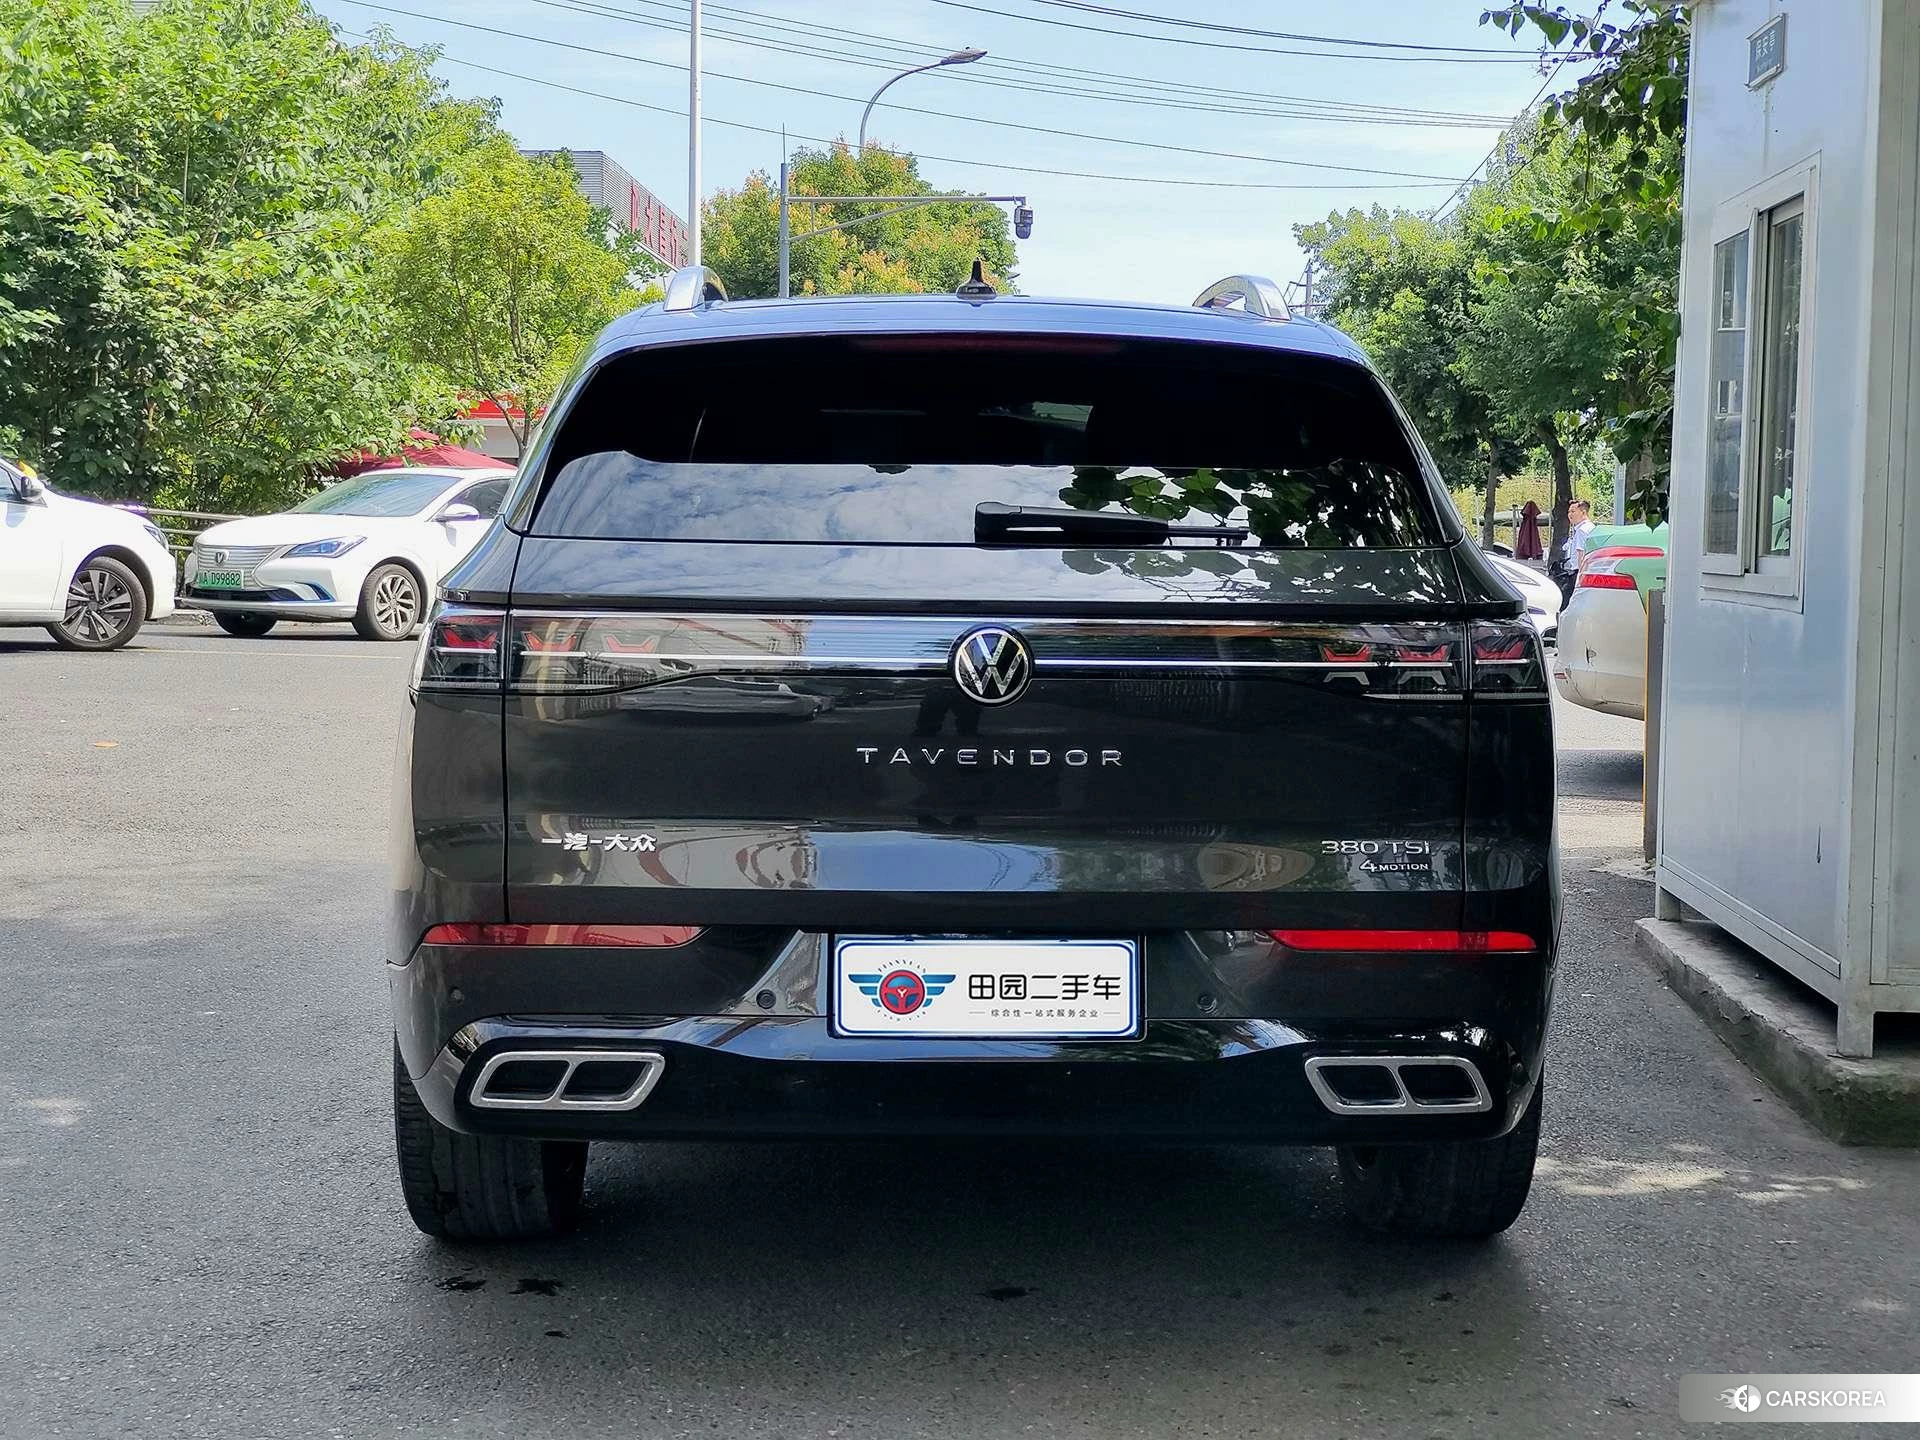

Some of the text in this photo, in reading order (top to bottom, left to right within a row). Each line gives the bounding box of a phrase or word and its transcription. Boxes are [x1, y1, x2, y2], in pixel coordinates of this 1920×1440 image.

[856, 747, 1123, 766] TAVENDOR
[1321, 840, 1430, 854] 380 TSI
[968, 974, 1121, 1000] 田园二手车
